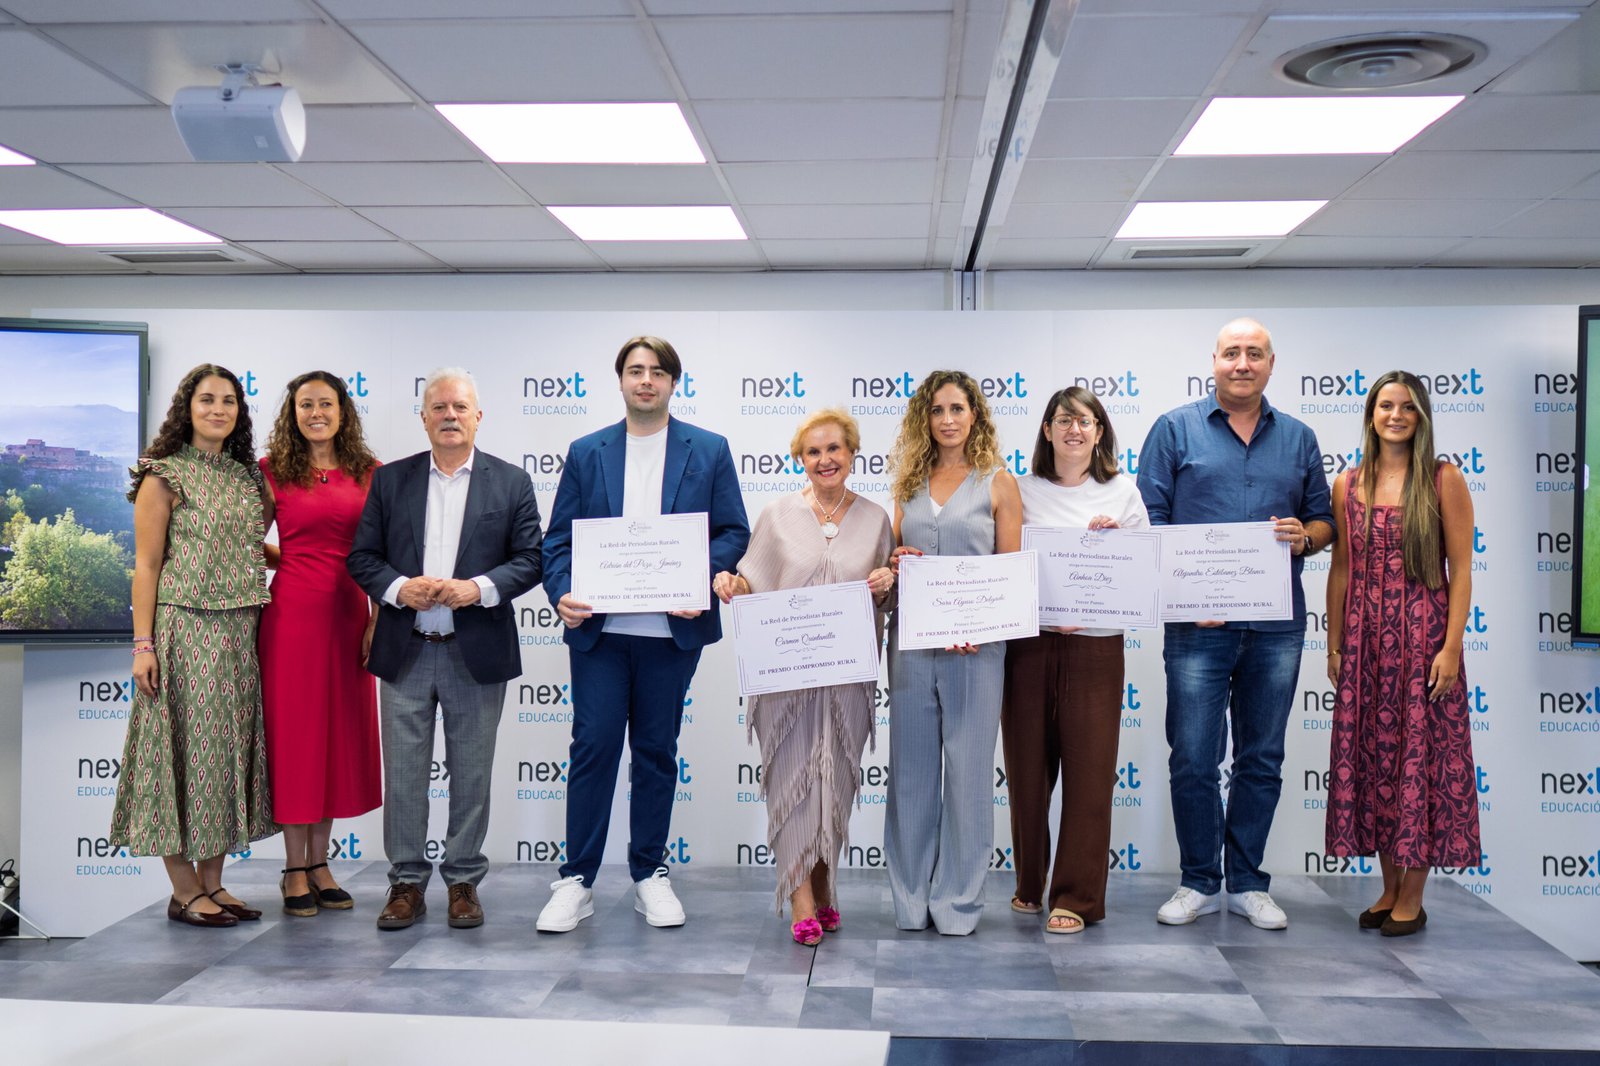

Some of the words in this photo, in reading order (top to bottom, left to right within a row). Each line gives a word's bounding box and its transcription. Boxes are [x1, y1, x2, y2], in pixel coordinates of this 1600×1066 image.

[523, 372, 587, 398] next
[741, 371, 806, 398] next
[852, 371, 916, 398] next
[980, 371, 1028, 398] ext
[1187, 375, 1216, 397] ne
[1301, 369, 1367, 396] next
[522, 404, 587, 415] EDUCACIÓN
[740, 404, 806, 415] EDUCACIÓN
[851, 404, 908, 416] EDUCACIÓ
[991, 403, 1028, 416] ACIÓN
[1105, 402, 1140, 415] ACIÓN
[1431, 401, 1485, 413] UCACIÓN
[1534, 402, 1576, 413] EDUCA
[1536, 452, 1575, 474] ne
[851, 482, 889, 493] EDUCA
[1536, 481, 1576, 492] EDUCA
[1537, 531, 1571, 553] ne
[1079, 552, 1110, 560] Periodistas
[1239, 565, 1266, 576] Blanco
[789, 613, 821, 622] Periodistas
[821, 610, 843, 618] Rurales
[1081, 608, 1120, 616] PERIODISMO
[1539, 611, 1571, 633] ne
[962, 625, 1000, 635] PERIODISMO
[519, 635, 563, 646] EDUCAC
[767, 666, 792, 674] PREMIO
[793, 661, 836, 671] COMPROMISO
[837, 658, 858, 666] RURAL
[79, 676, 135, 702] nex
[519, 684, 573, 705] nex
[1303, 690, 1335, 712] ne
[1540, 686, 1600, 714] nex
[518, 712, 574, 723] EDUCACIÓ
[1540, 720, 1600, 732] EDUCACIÓ
[518, 761, 569, 782] nex
[1113, 761, 1141, 789] xt
[1541, 766, 1600, 795] nex
[77, 787, 115, 797] EDUCA
[517, 789, 566, 800] EDUCACI
[1541, 801, 1600, 813] EDUCACIÓ
[328, 832, 362, 860] xt
[517, 840, 566, 862] nex
[662, 837, 691, 864] xt
[1109, 842, 1141, 870] xt
[76, 864, 142, 876] EDUCACIÓN
[1542, 855, 1600, 877] nex
[1542, 884, 1600, 896] EDUCACIÓ
